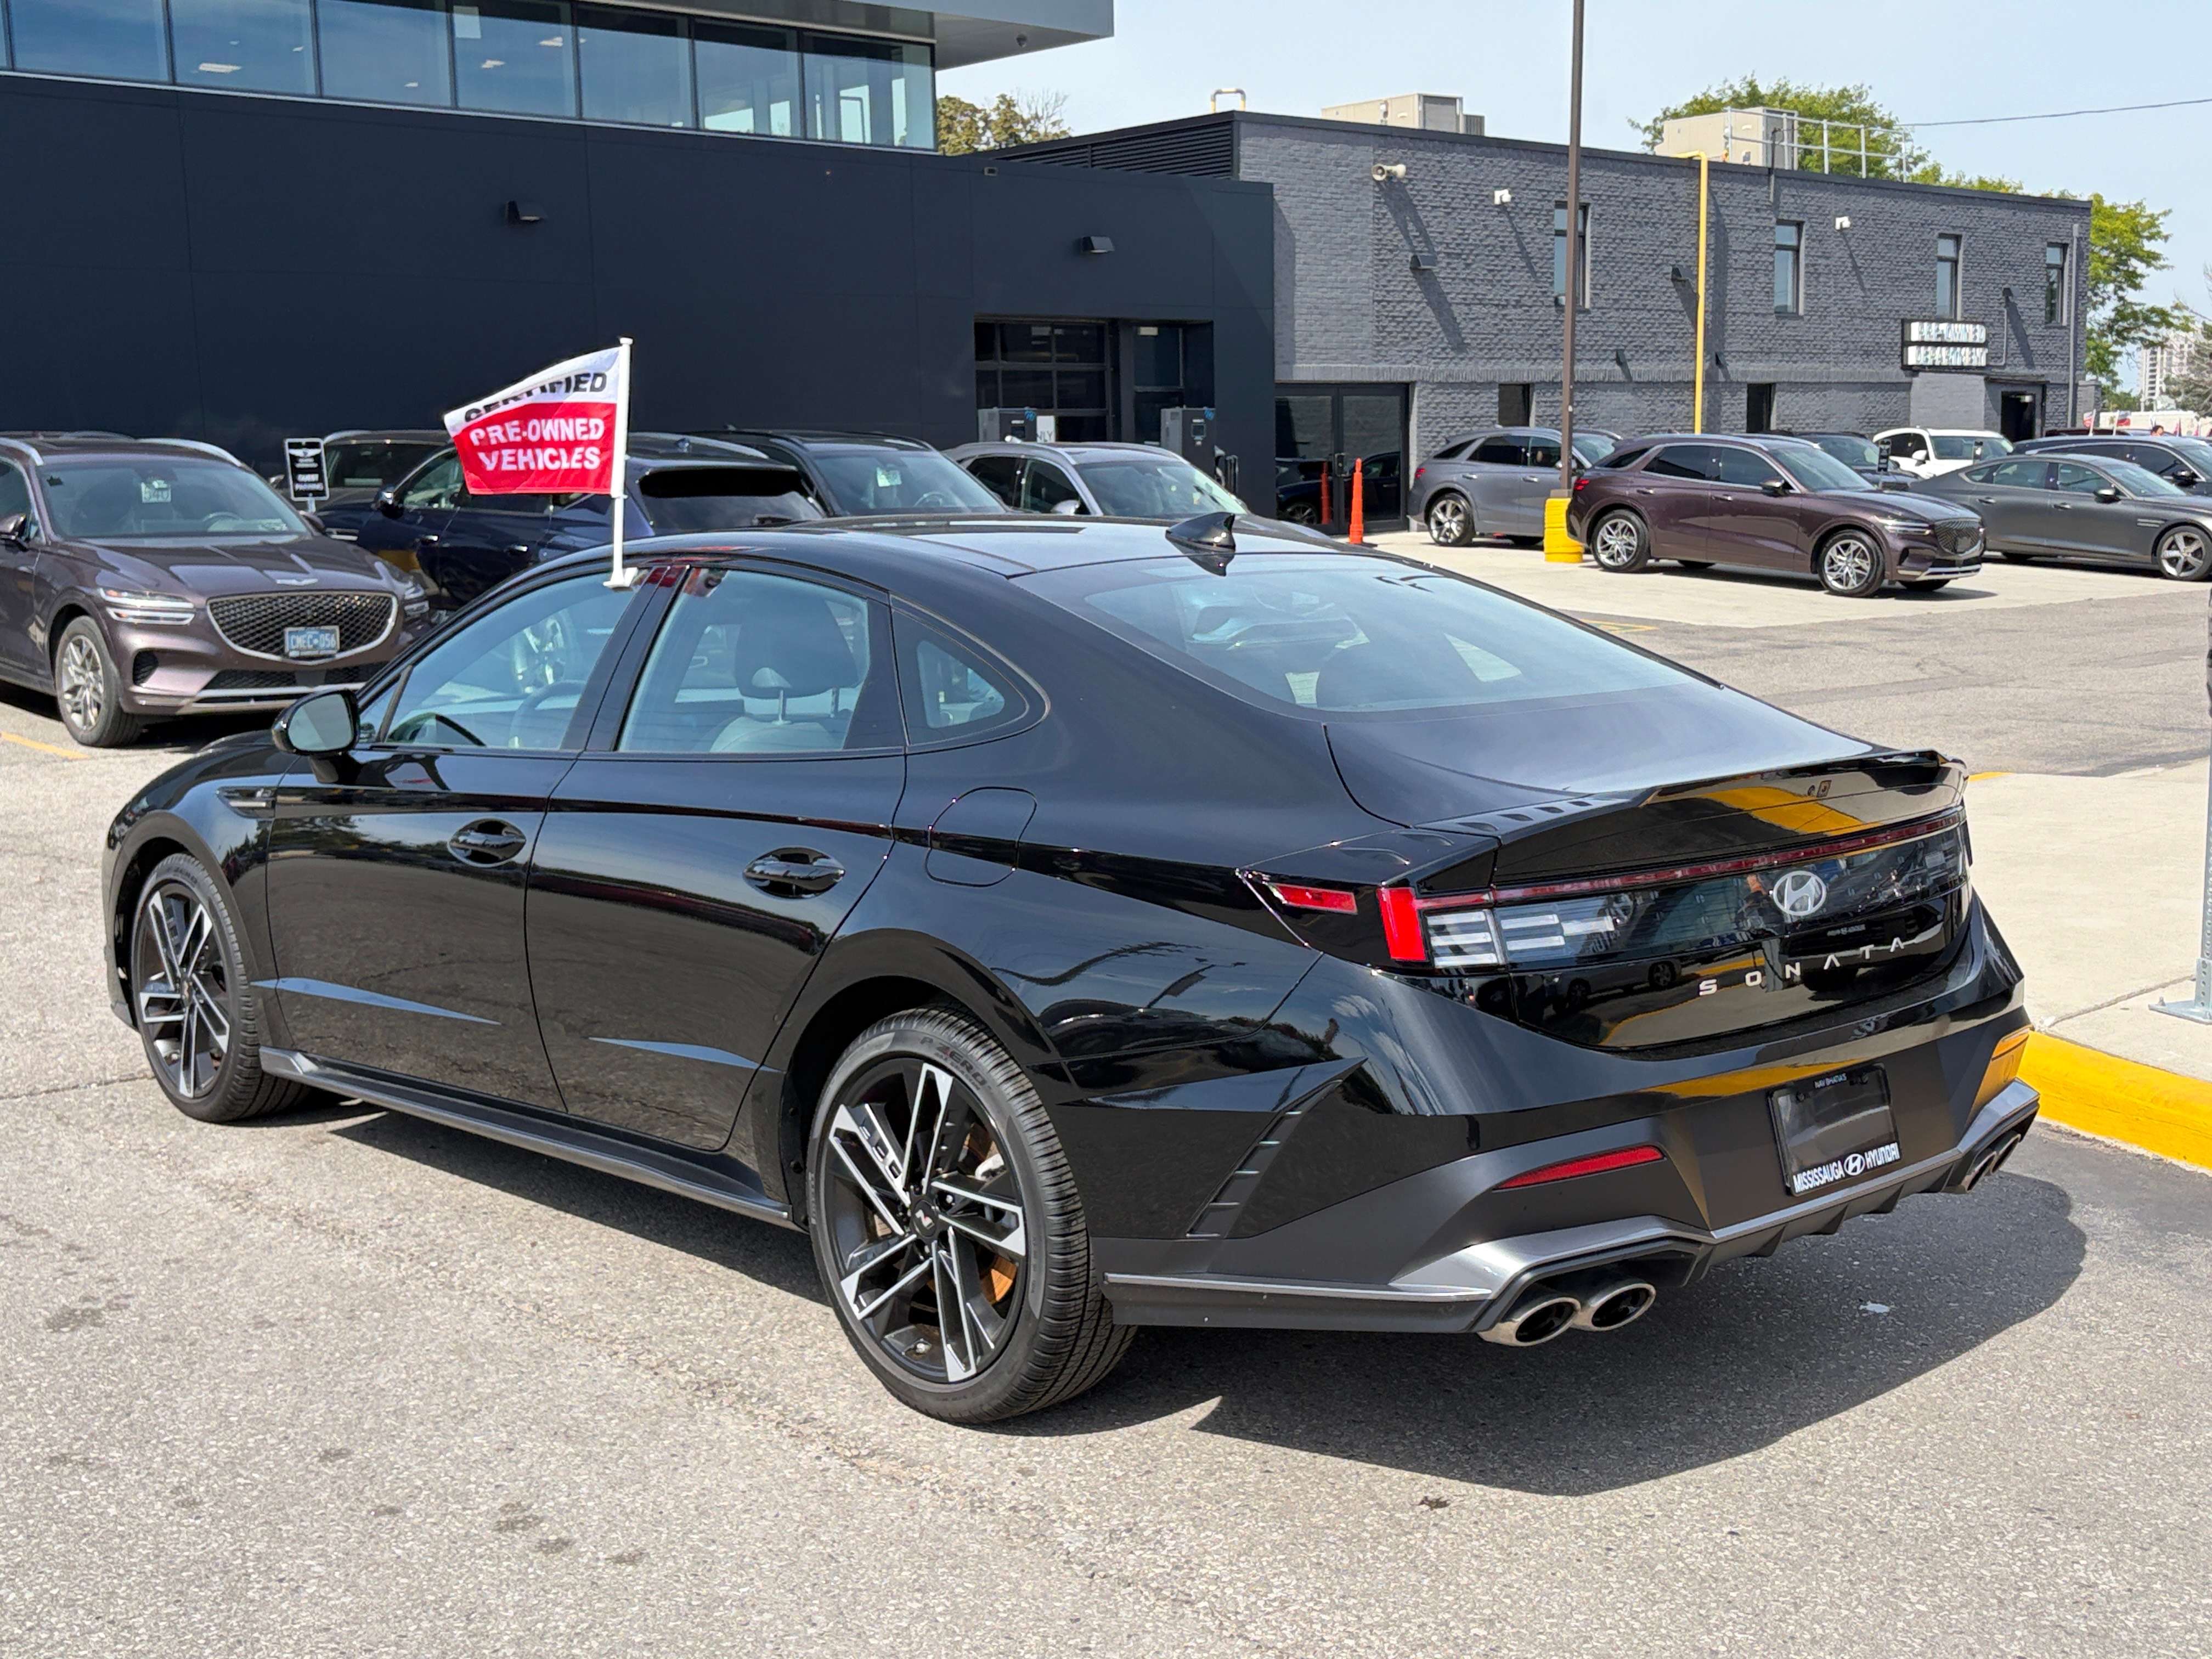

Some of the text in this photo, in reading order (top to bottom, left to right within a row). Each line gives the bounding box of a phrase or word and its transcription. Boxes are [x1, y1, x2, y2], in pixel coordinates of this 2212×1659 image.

[469, 418, 605, 446] PRE-OWNED
[477, 447, 601, 471] VEHICLES
[1699, 936, 1905, 996] SONATA
[936, 1042, 988, 1086] ZERO
[1792, 1142, 1900, 1193] MISSISSAUGA HYUNDAI
